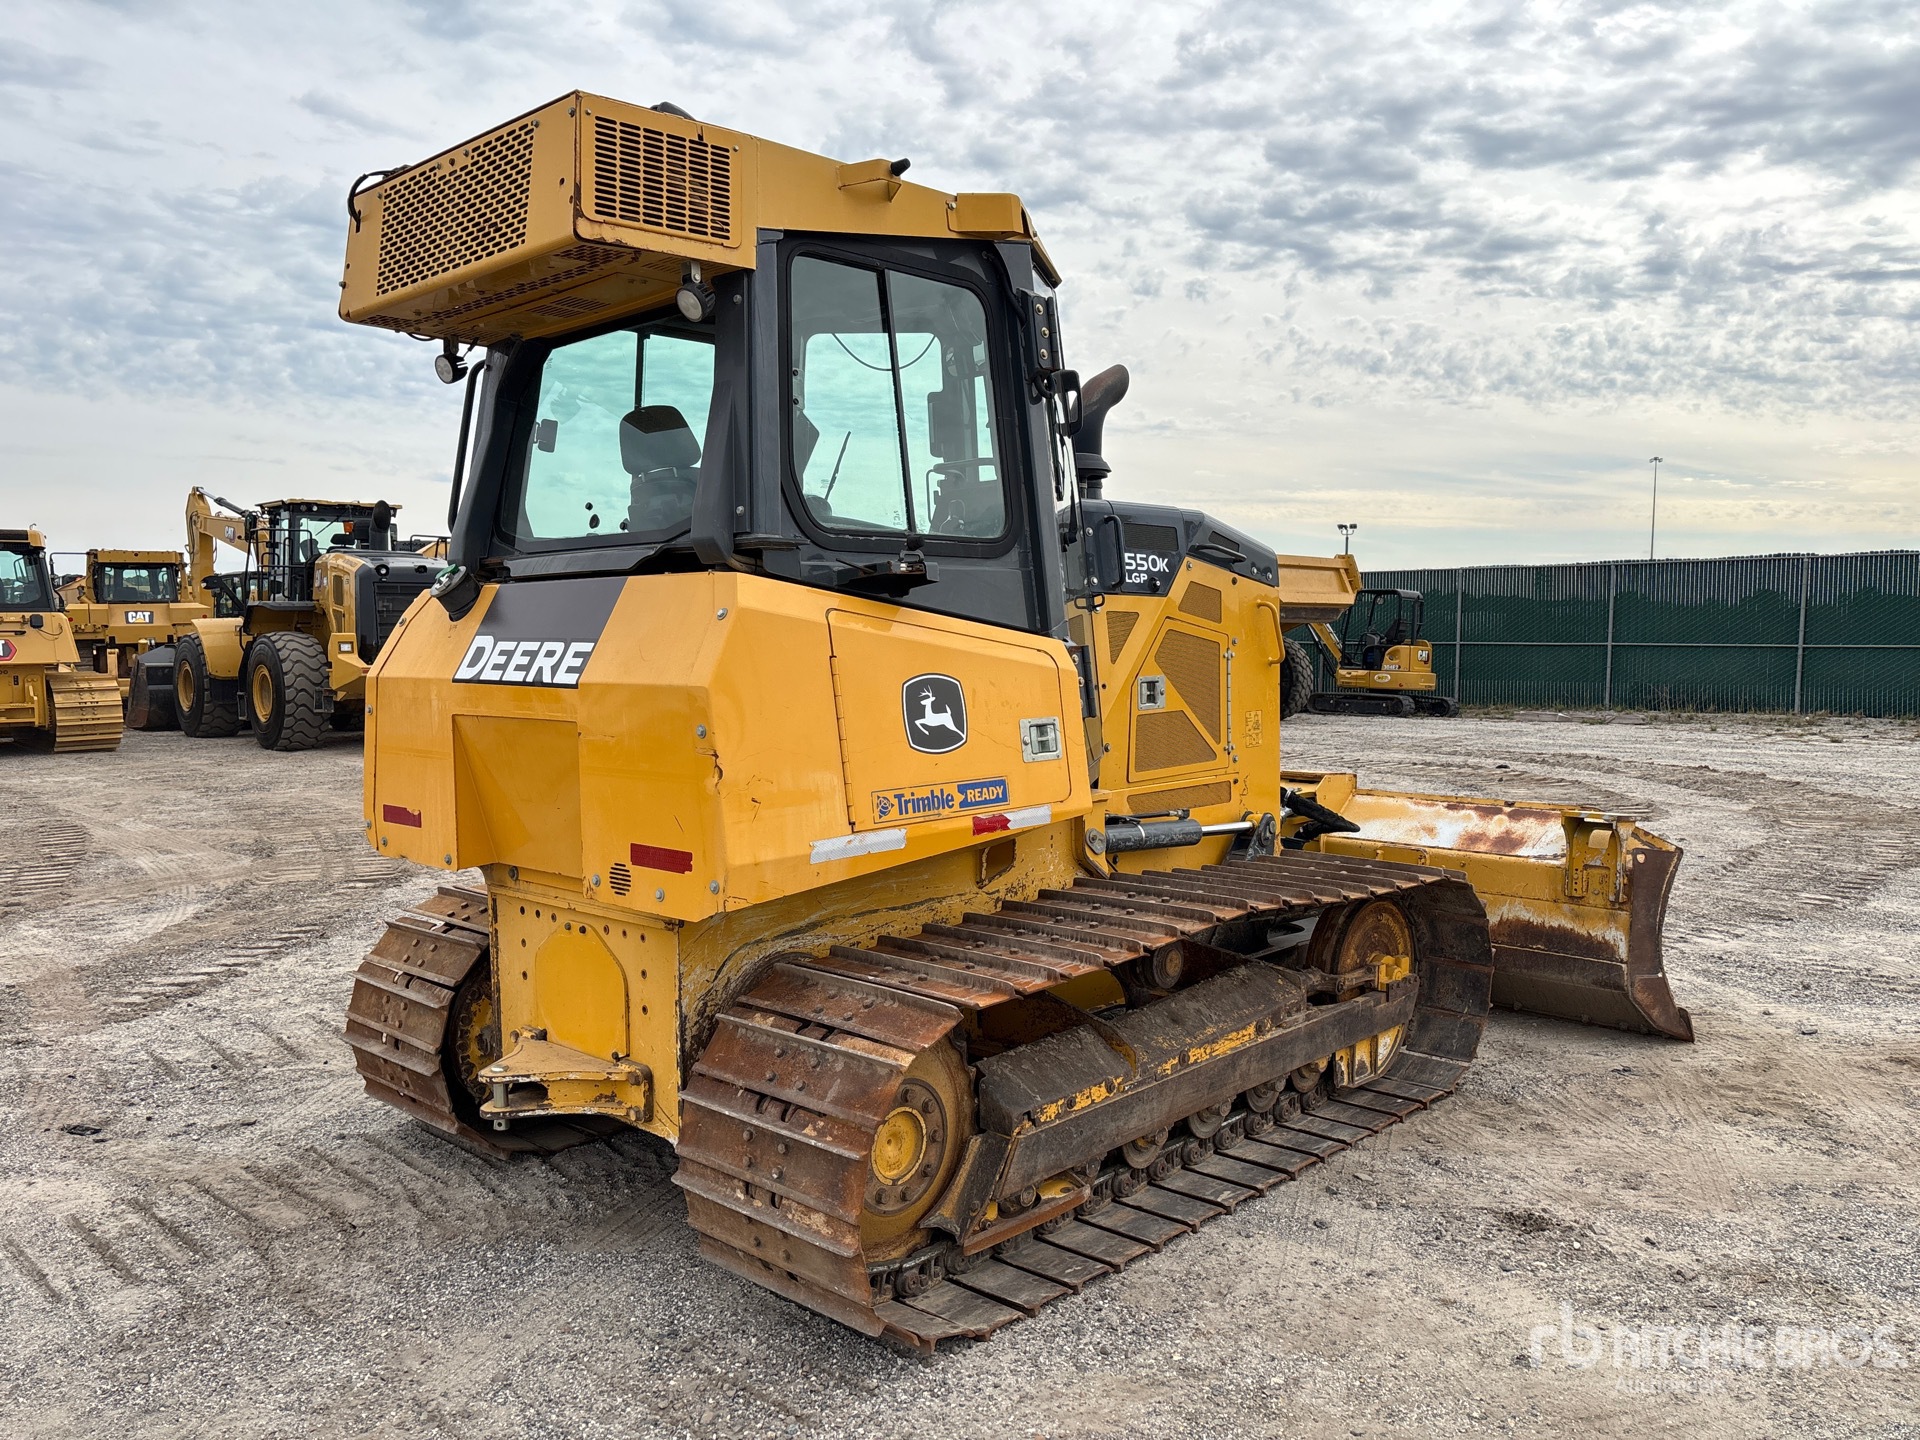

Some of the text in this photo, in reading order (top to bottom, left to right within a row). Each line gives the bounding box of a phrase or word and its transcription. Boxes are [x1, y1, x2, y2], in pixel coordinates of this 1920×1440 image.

[1124, 553, 1169, 572] 550K
[1125, 572, 1148, 583] LGP
[128, 611, 150, 623] CAT
[454, 635, 595, 684] DEERE
[1417, 650, 1429, 661] CAT
[894, 785, 1004, 815] Trimble READY
